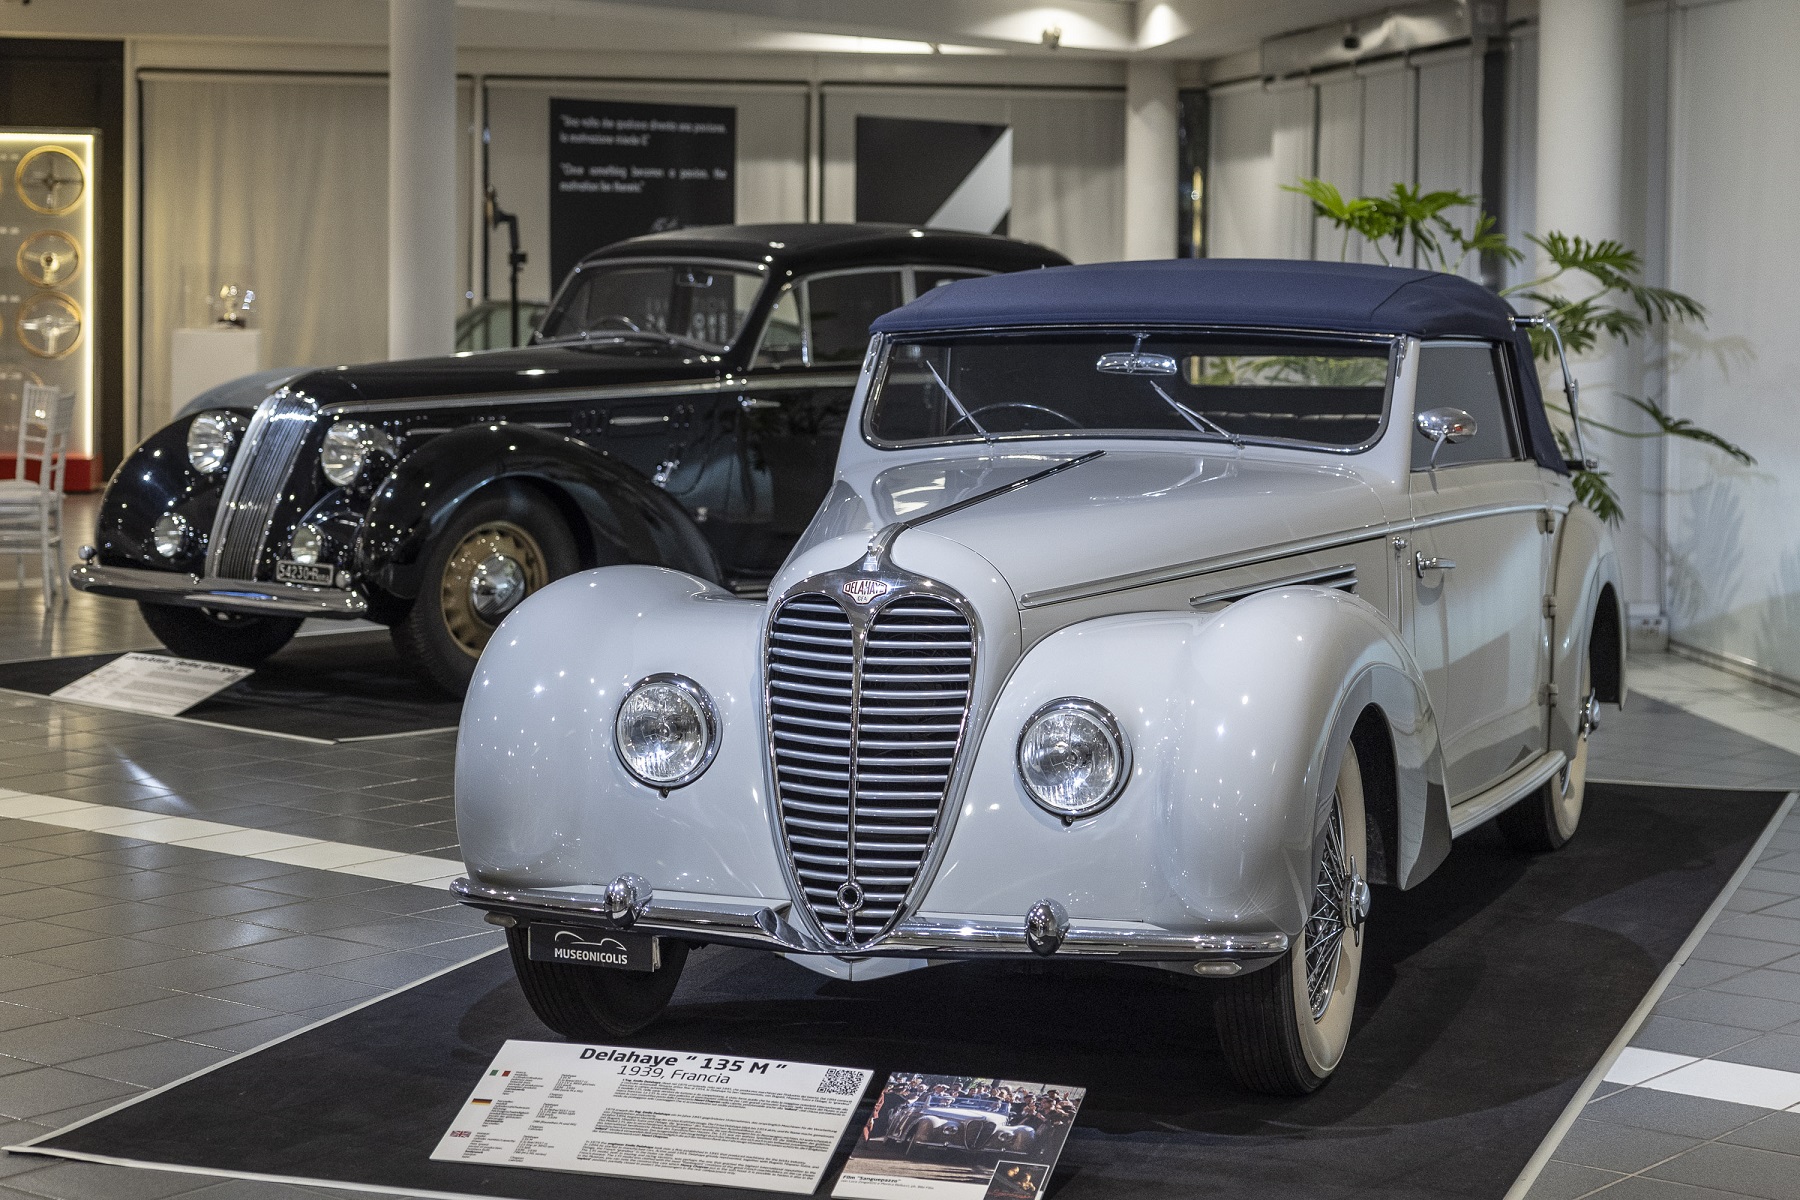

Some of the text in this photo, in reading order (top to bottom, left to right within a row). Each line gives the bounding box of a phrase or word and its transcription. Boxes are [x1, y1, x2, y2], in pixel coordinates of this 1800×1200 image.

[554, 948, 628, 965] MUSEONICOLIS
[579, 1047, 679, 1067] Delahaye
[699, 1057, 745, 1072] 135
[748, 1062, 770, 1075] M
[616, 1065, 731, 1084] 1939, Francia
